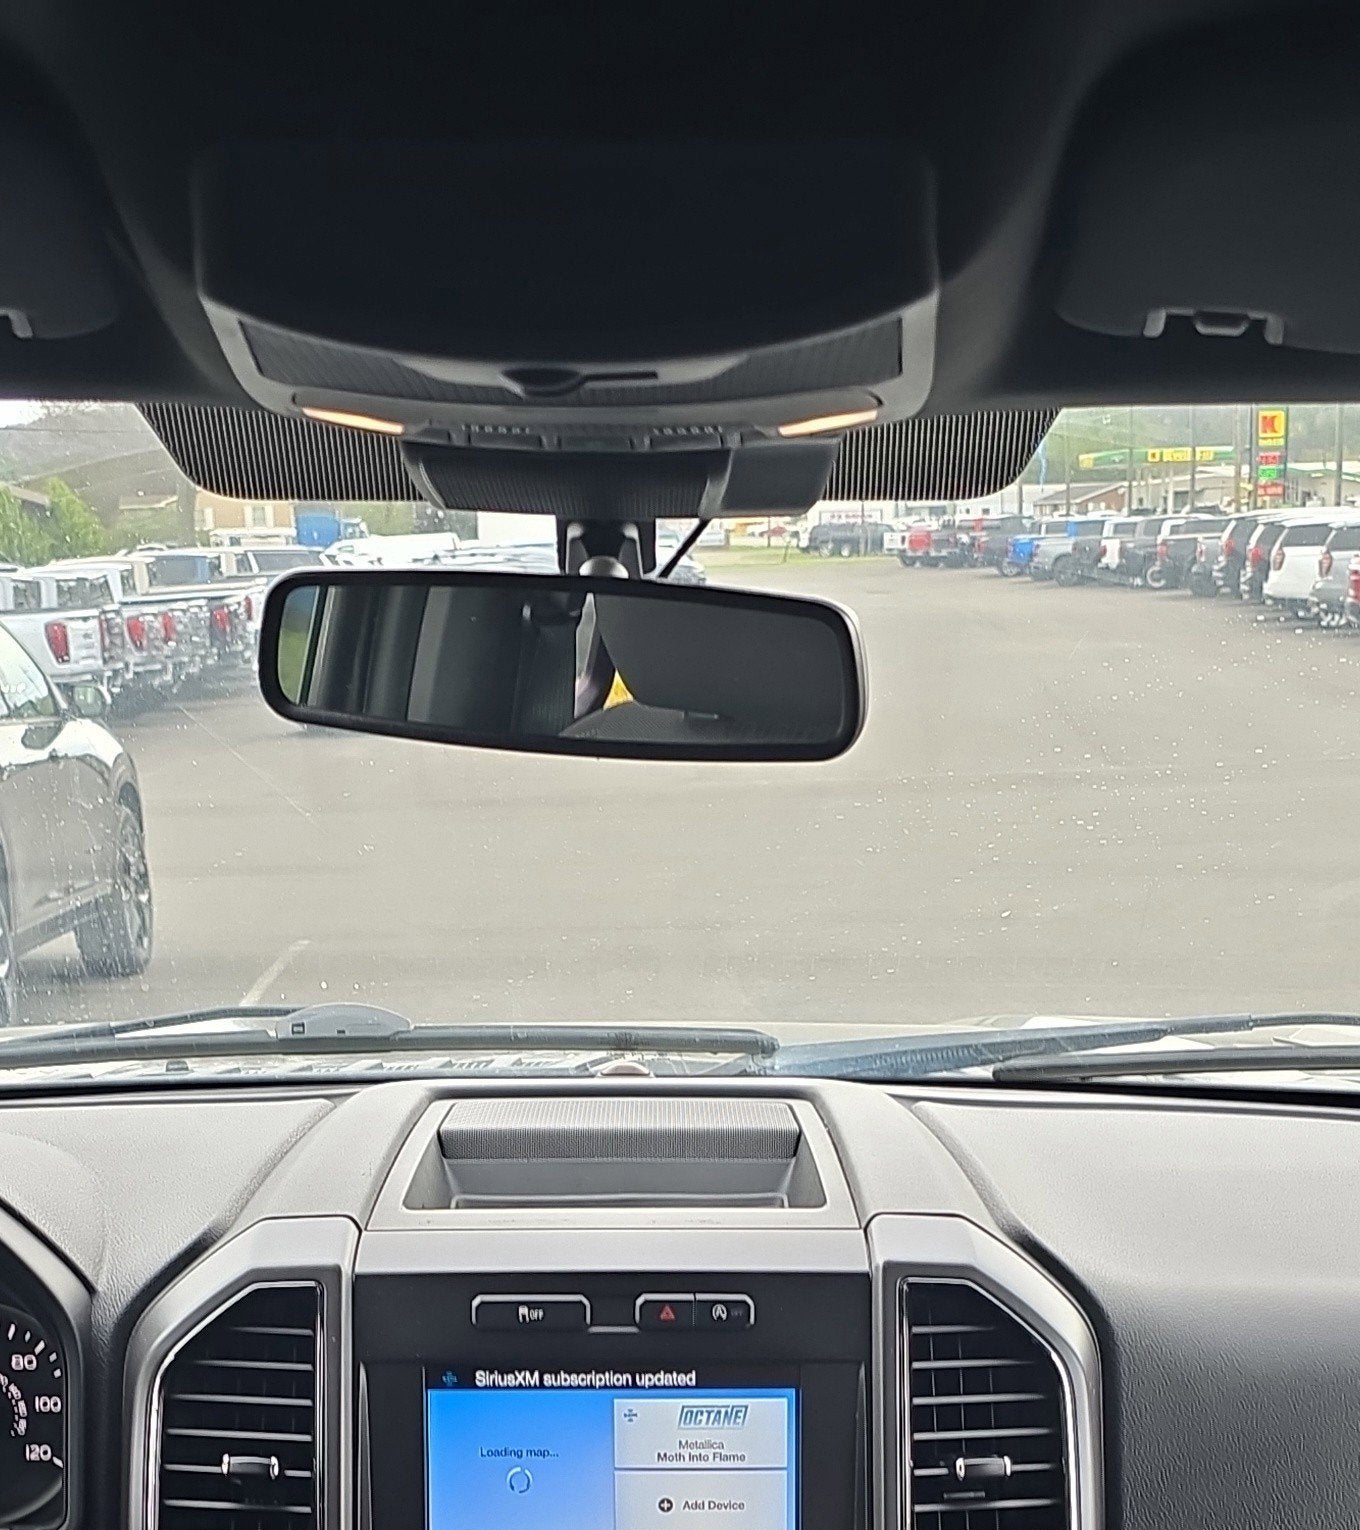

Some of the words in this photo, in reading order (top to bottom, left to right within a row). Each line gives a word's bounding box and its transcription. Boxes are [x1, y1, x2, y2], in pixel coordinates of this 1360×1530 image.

[11, 1354, 37, 1371] 80
[475, 1370, 540, 1386] SiriusXM
[543, 1370, 633, 1388] subscription
[636, 1370, 696, 1388] updated
[35, 1396, 62, 1413] 100
[683, 1407, 745, 1427] OCTANE
[25, 1444, 52, 1461] 120
[480, 1447, 523, 1460] Loading
[678, 1439, 725, 1451] Metallica
[657, 1452, 686, 1463] Moth
[713, 1452, 746, 1463] Flame
[682, 1500, 705, 1511] Add
[708, 1500, 745, 1511] Device
